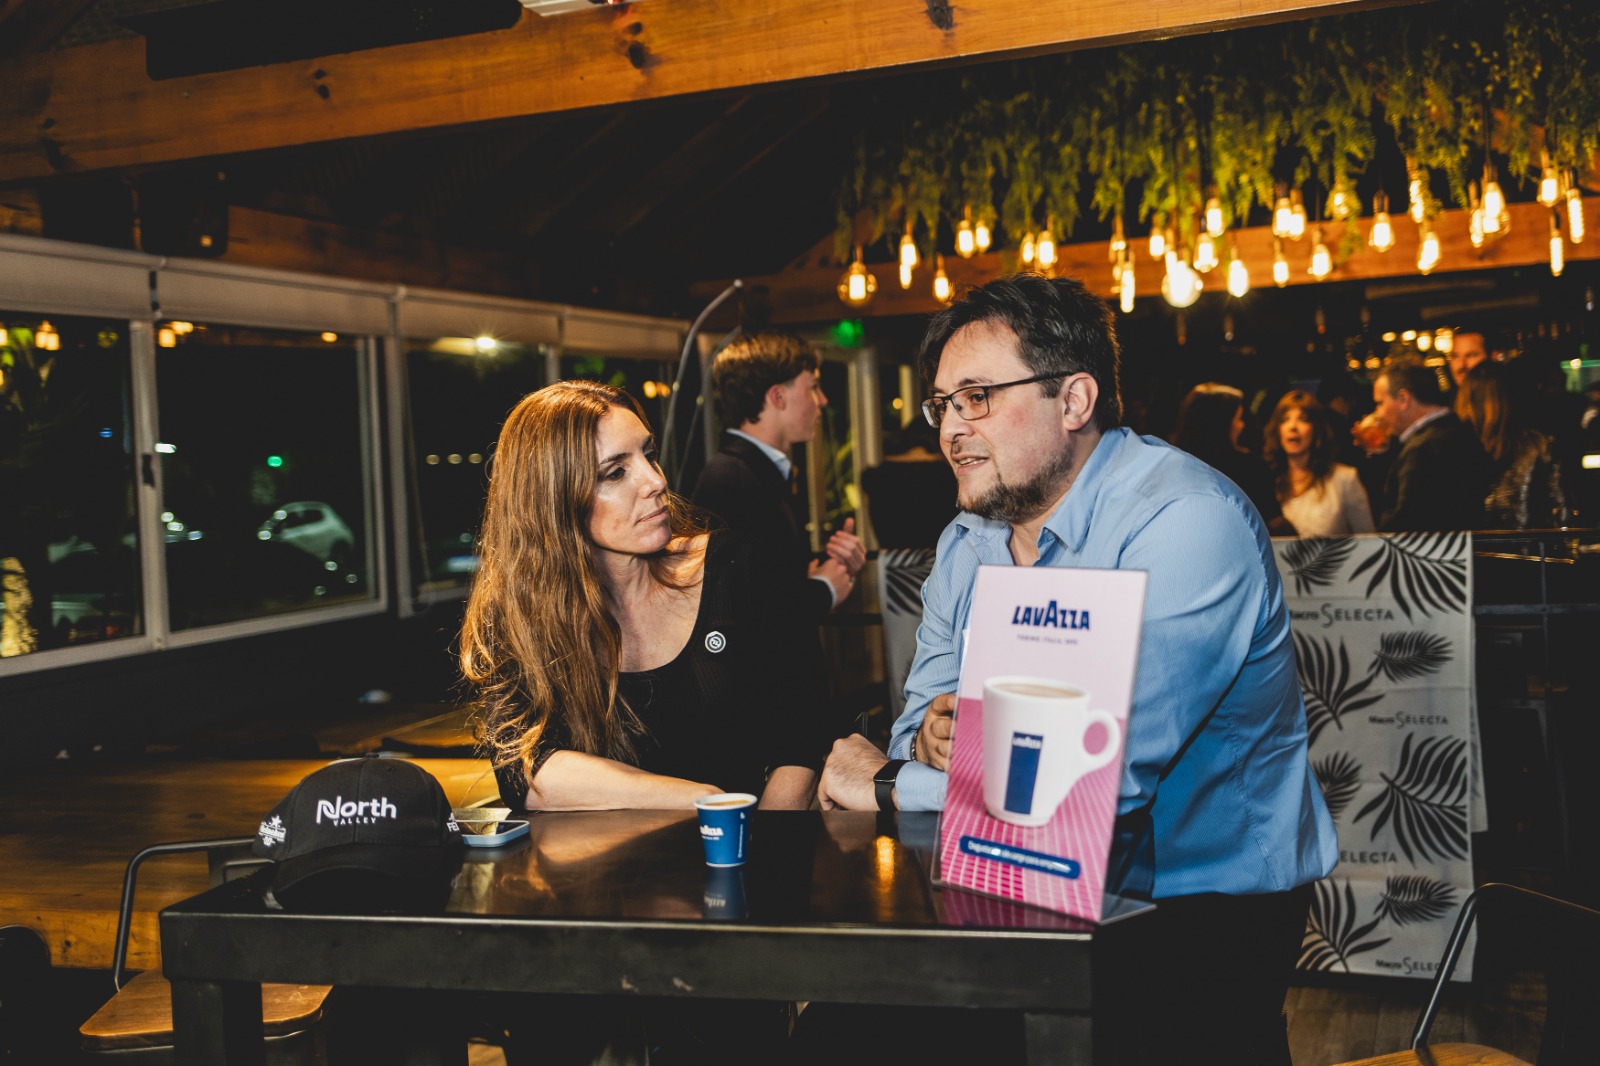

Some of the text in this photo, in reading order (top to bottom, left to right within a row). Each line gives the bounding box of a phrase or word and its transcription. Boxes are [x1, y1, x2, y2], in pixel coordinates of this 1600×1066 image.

[1011, 600, 1090, 630] LAVAZZA
[1320, 602, 1395, 629] SELECTA
[1396, 711, 1449, 729] SELECTA
[316, 795, 397, 824] North
[333, 816, 377, 827] VALLEY
[1339, 850, 1399, 865] ELECTA
[1402, 956, 1441, 975] SELEC
